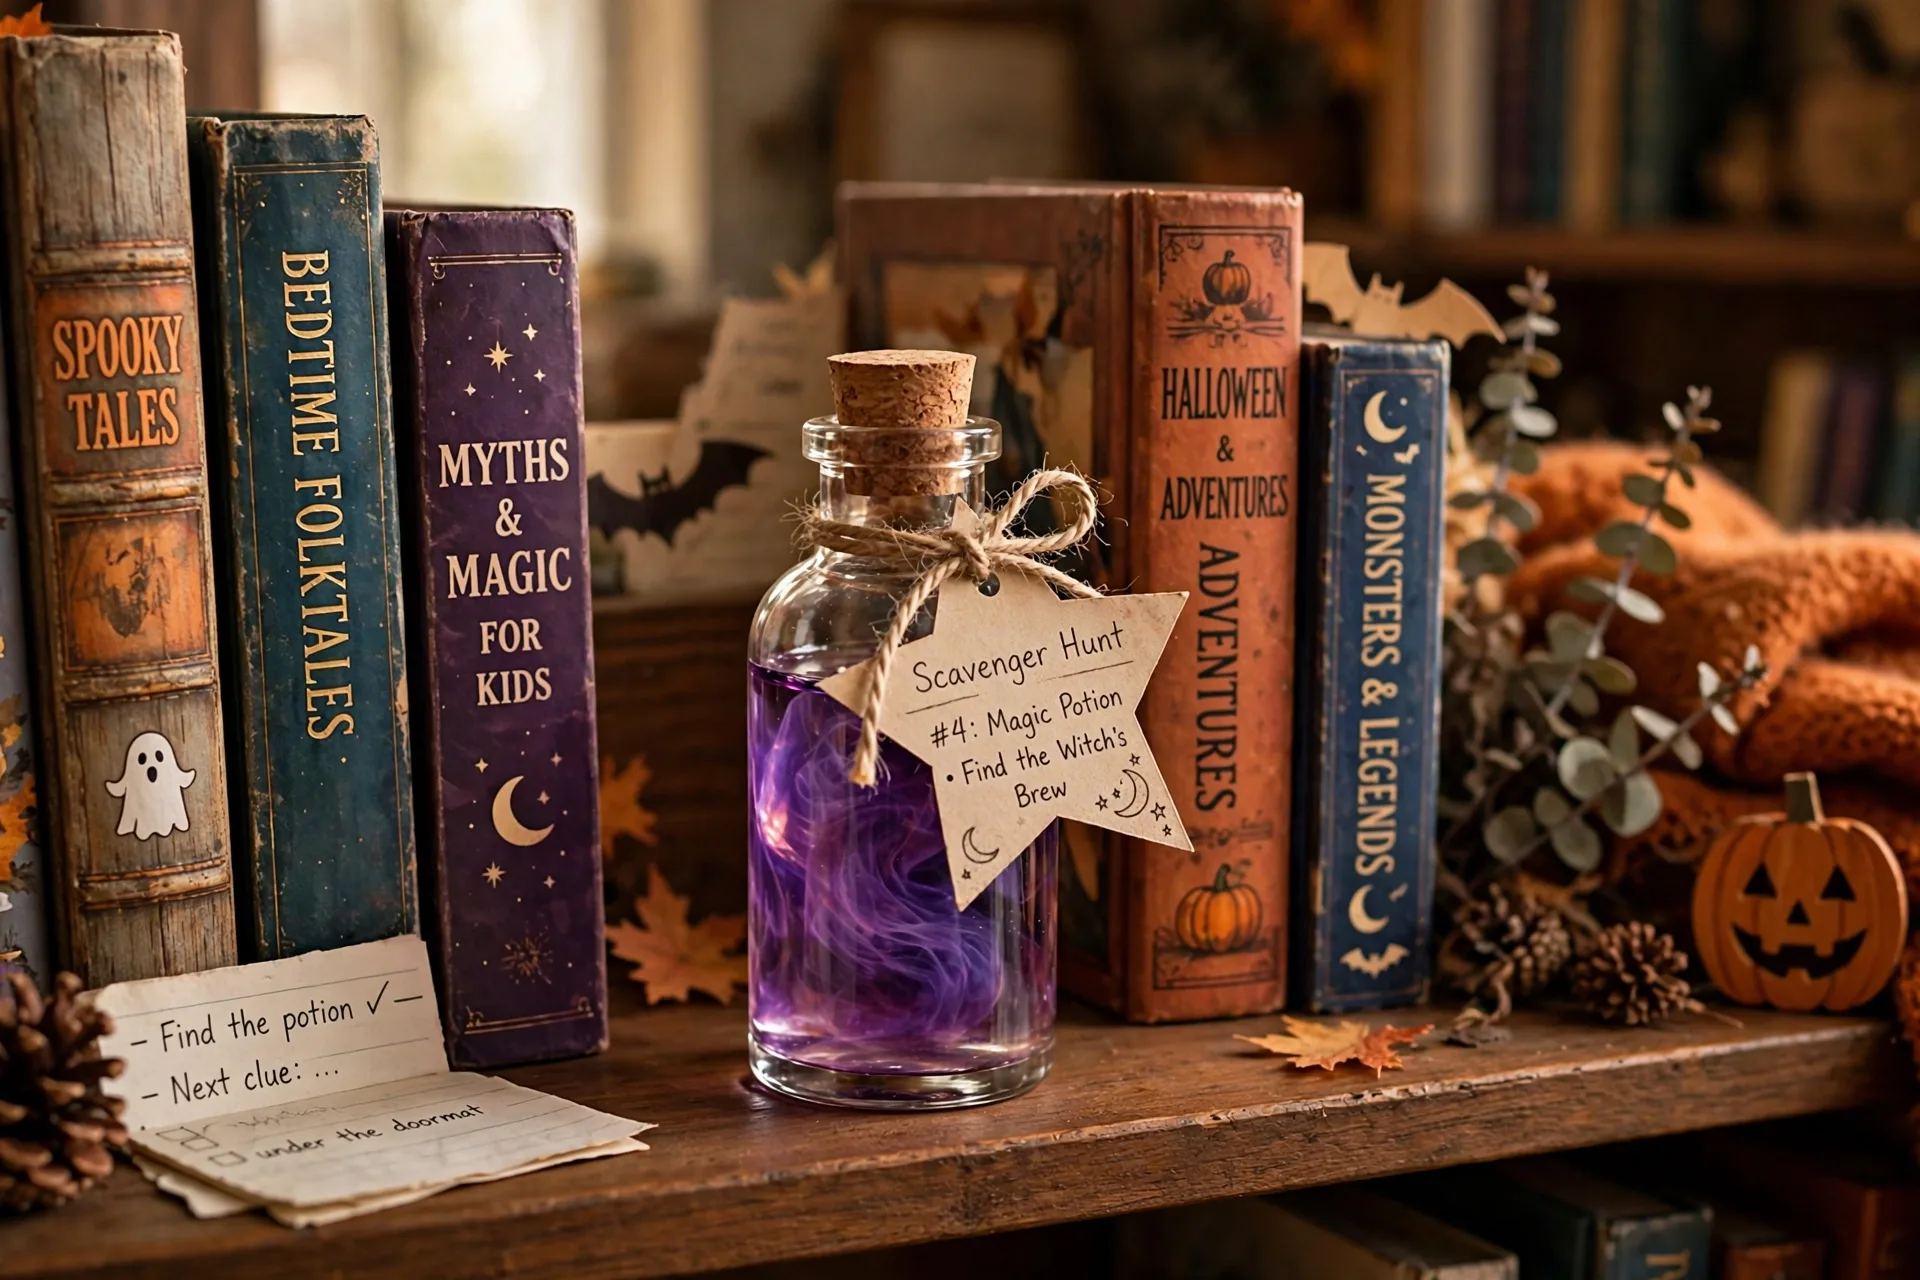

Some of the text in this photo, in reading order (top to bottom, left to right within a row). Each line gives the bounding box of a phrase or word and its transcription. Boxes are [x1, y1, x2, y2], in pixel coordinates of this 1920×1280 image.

[52, 315, 184, 381] SPOOKY
[1161, 367, 1287, 420] HALLOWEEN
[68, 387, 181, 453] TALES
[438, 438, 570, 488] MYTHS
[1216, 434, 1235, 462] &
[281, 249, 355, 740] BEDTIME FOLKTALES
[495, 498, 522, 537] &
[1160, 474, 1289, 520] ADVENTURES
[446, 547, 572, 599] MAGIC
[480, 618, 543, 654] FOR
[912, 621, 1124, 694] Scavenger Hunt
[476, 667, 552, 706] KIDS
[1195, 541, 1240, 812] ADVENTURES
[1355, 474, 1407, 876] MONSTERS & LEGENDS
[930, 688, 1123, 749] #4: Magic Potion
[962, 727, 1128, 785] Find the Witch's
[1014, 780, 1067, 808] Brew
[161, 1014, 216, 1052] Find
[228, 1009, 270, 1039] the
[283, 1000, 354, 1042] potion
[171, 1067, 230, 1104] Next
[244, 1060, 302, 1090] clue:
[256, 1103, 485, 1160] under the doormat
